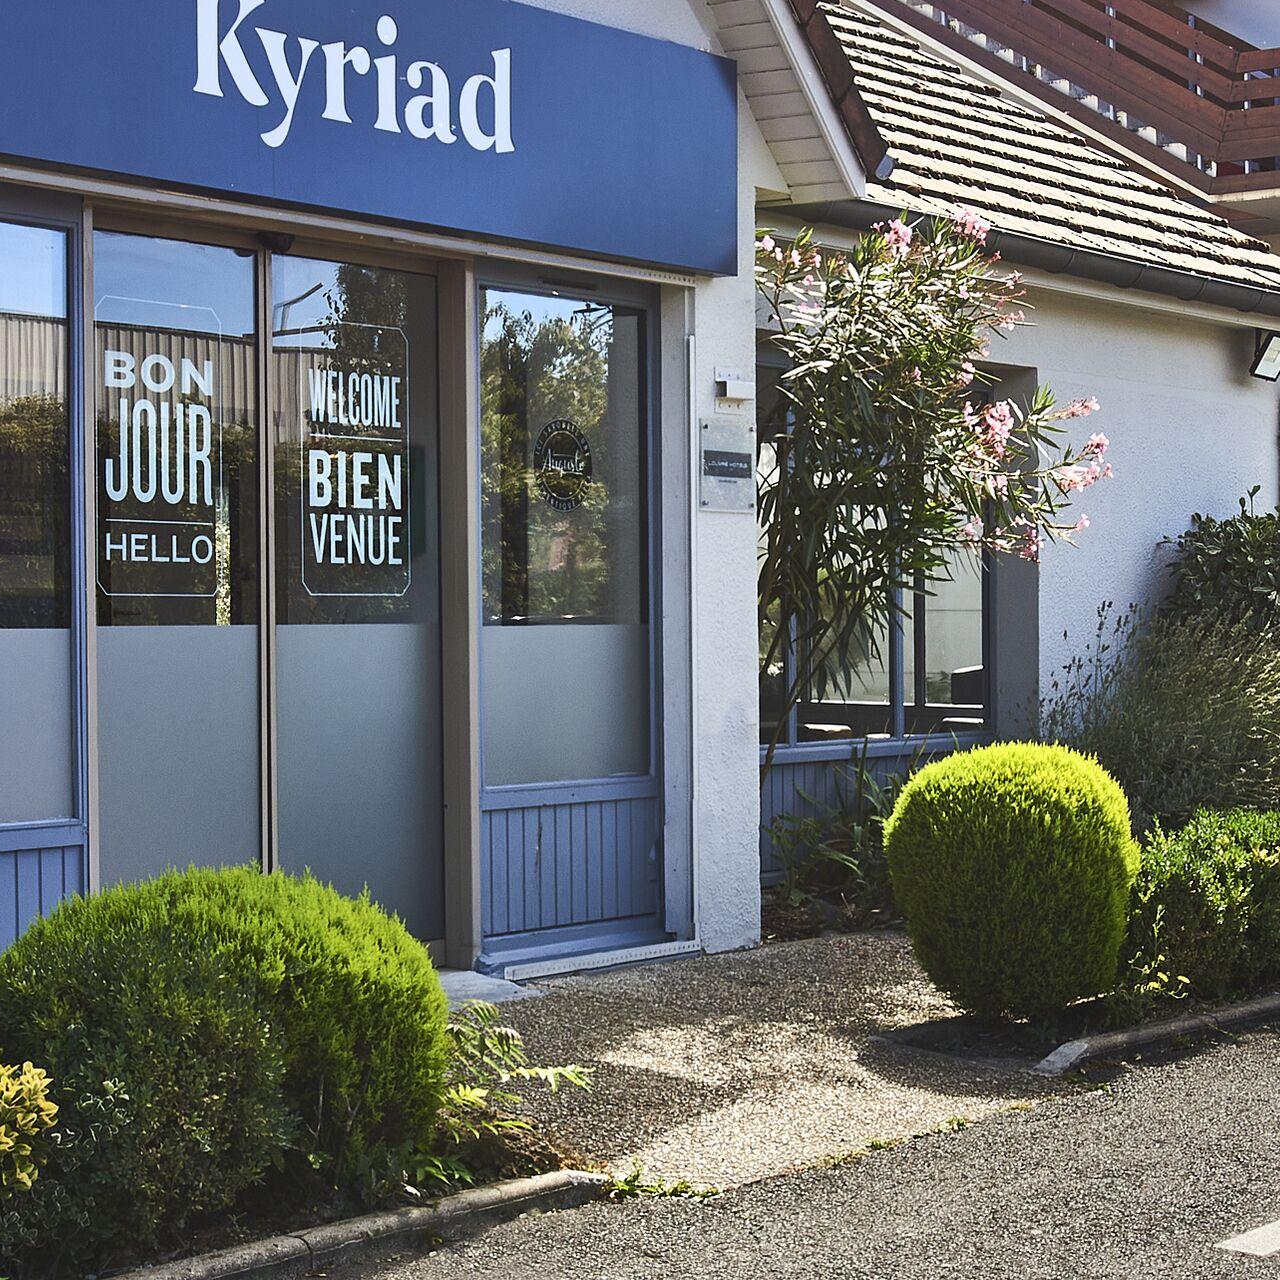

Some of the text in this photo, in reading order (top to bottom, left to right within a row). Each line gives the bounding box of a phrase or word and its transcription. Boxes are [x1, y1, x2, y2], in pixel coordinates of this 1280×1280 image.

[104, 349, 213, 397] BON
[308, 368, 402, 428] WELCOME
[105, 398, 213, 506] JOUR
[308, 449, 402, 510] BIEN
[105, 532, 213, 564] HELLO
[309, 512, 403, 565] VENUE
